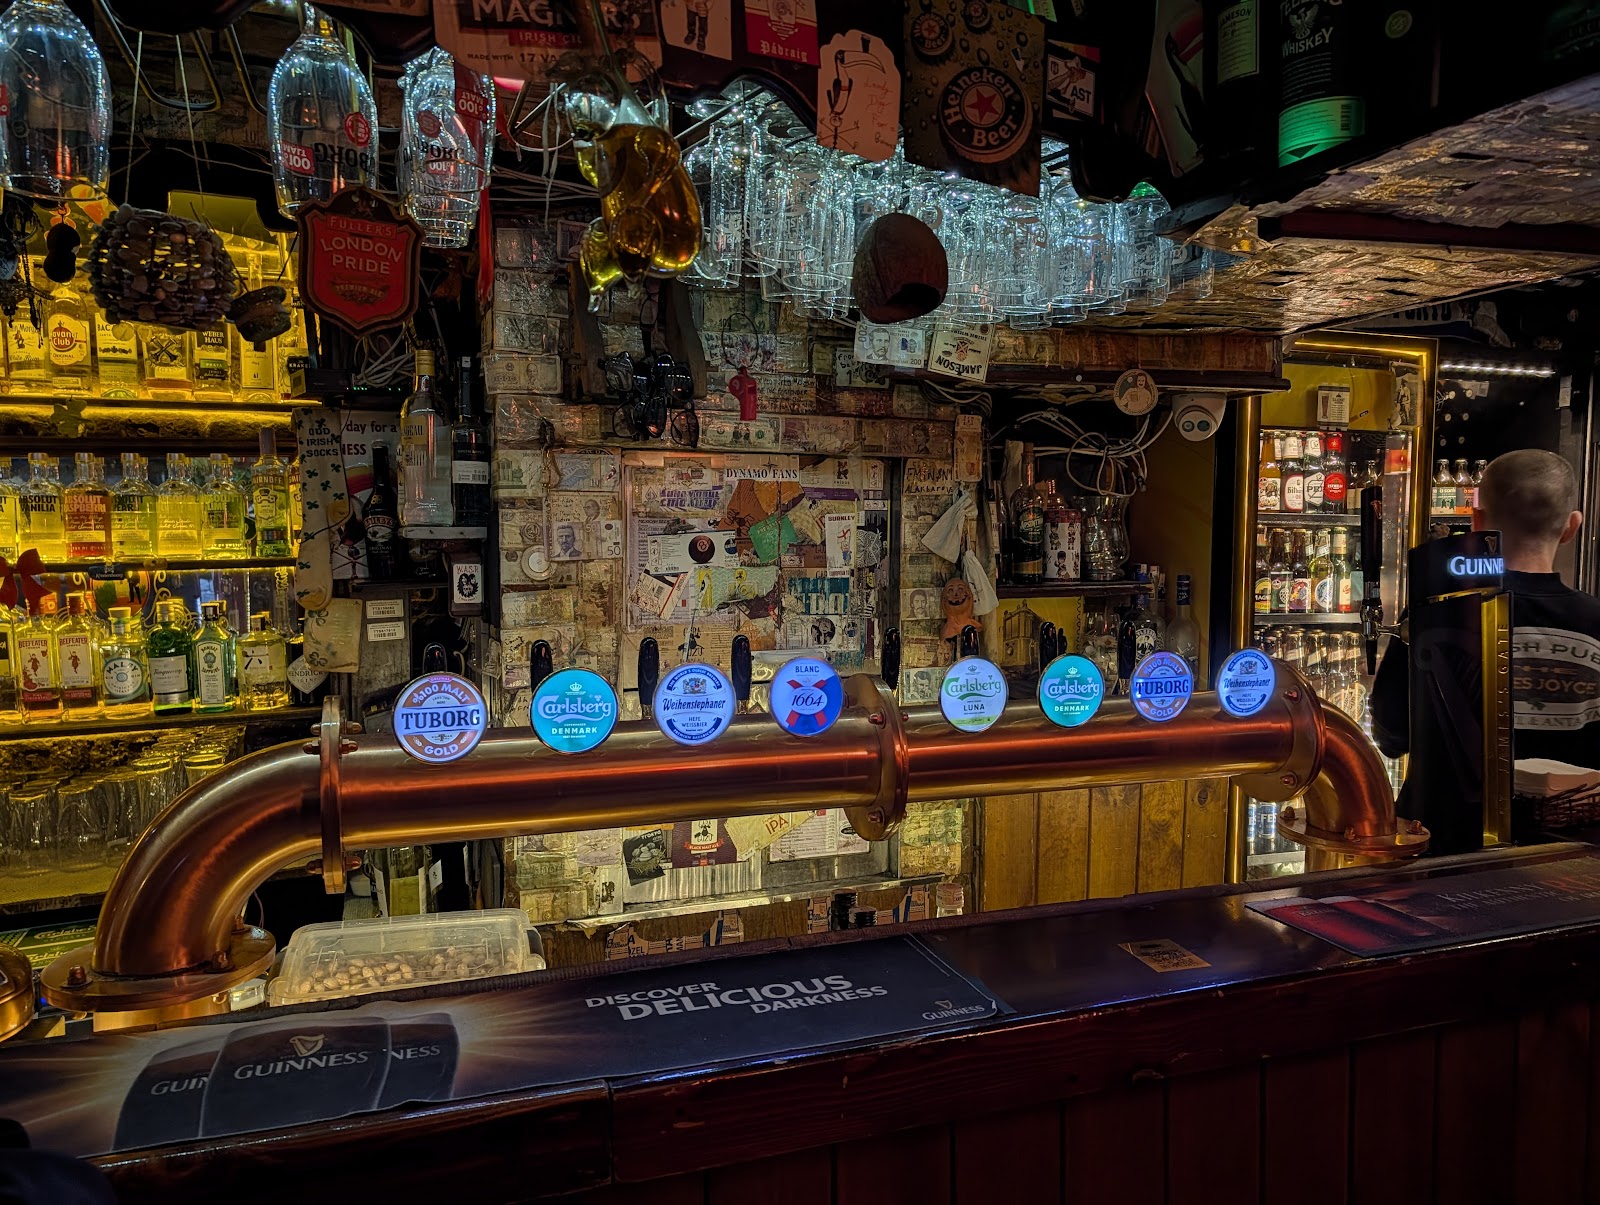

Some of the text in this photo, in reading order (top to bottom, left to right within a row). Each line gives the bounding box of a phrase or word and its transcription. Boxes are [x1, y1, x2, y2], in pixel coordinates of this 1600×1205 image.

[472, 0, 641, 31] MAGNR
[519, 31, 557, 44] IRISH
[1282, 26, 1334, 59] WHISKEY
[467, 53, 490, 61] MADE
[492, 54, 514, 62] WITH
[519, 53, 536, 64] 17
[944, 68, 1017, 126] Heineken
[971, 114, 1018, 147] Beer
[319, 236, 402, 263] LONDON
[332, 254, 392, 275] PRIDE
[202, 330, 224, 338] WEBER
[53, 338, 71, 346] Club
[909, 358, 922, 366] 200
[936, 355, 983, 377] JAMESON
[309, 426, 331, 436] ODD
[346, 420, 367, 435] day
[370, 420, 387, 433] for
[390, 423, 398, 433] a
[306, 437, 334, 447] IRISH
[306, 448, 340, 458] SOCKS
[726, 468, 798, 479] DYNAMO FANS
[19, 495, 57, 504] ABSOLUT
[64, 495, 103, 504] ABSOLUT
[20, 503, 56, 512] VANILIA
[364, 517, 395, 529] BAILEYS
[607, 545, 621, 556] 50
[18, 639, 48, 649] BEEFEATER
[59, 637, 88, 646] BEEFEATER
[1498, 622, 1510, 675] GATE
[795, 665, 820, 674] BLANC
[1162, 658, 1182, 675] MALT
[412, 683, 439, 704] %100
[441, 682, 471, 703] MALT
[943, 676, 1002, 700] Carlsberg
[1044, 677, 1101, 702] Carlsberg
[1135, 678, 1189, 696] TUBORG
[1536, 678, 1597, 695] JOYCE
[662, 697, 726, 712] Weihenstephaner
[791, 692, 825, 707] 1664
[537, 695, 613, 720] Carlsberg
[963, 703, 985, 712] LUNA
[1054, 704, 1090, 712] DENMARK
[1149, 707, 1174, 718] GOLD
[401, 708, 481, 730] TUBORG
[551, 726, 598, 735] DENMARK
[424, 744, 459, 756] GOLD
[765, 814, 789, 836] IPA
[585, 981, 721, 1009] DISCOVER
[617, 974, 853, 1021] DELICIOUS
[750, 985, 889, 1015] DARKNESS
[921, 1003, 985, 1021] GUINNESS
[234, 1050, 369, 1081] GUINNESS
